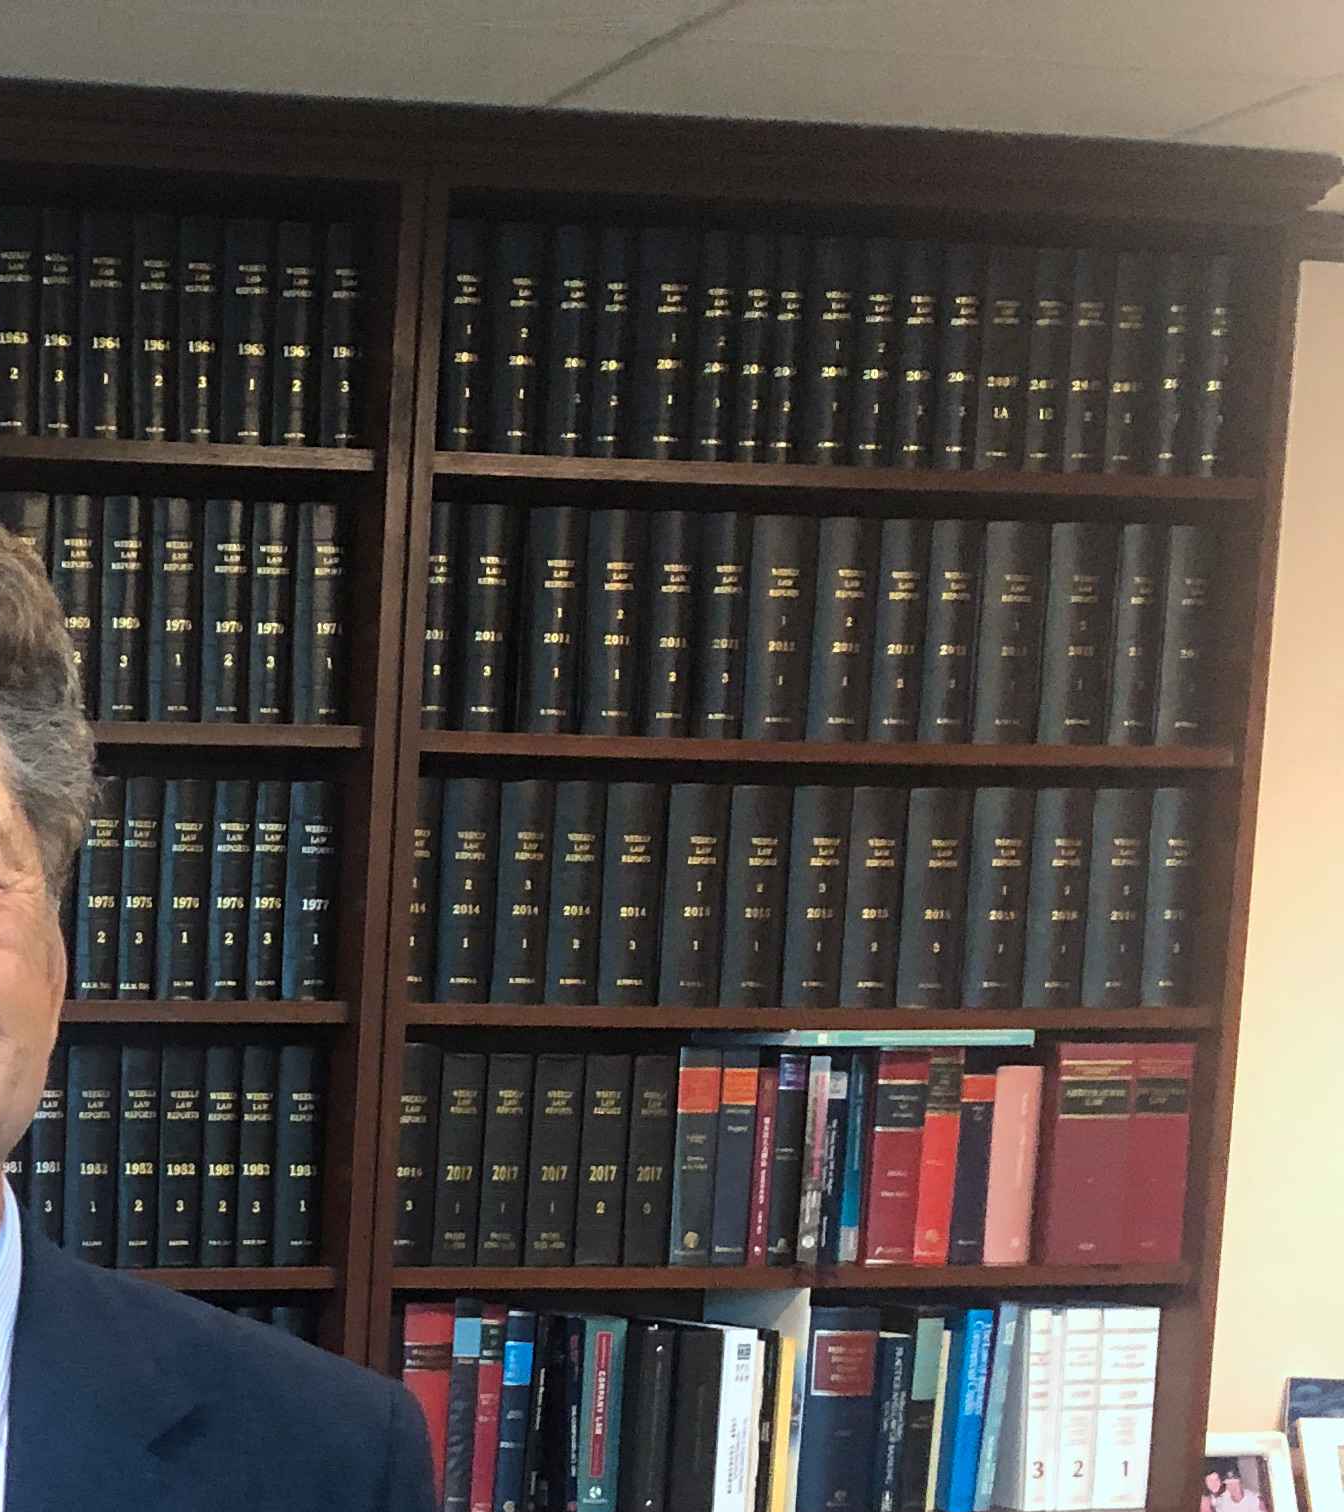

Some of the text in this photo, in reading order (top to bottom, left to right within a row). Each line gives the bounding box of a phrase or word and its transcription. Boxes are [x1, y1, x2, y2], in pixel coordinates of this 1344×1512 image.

[0, 332, 29, 345] 1963
[10, 368, 18, 380] 2
[103, 373, 109, 385] 1
[154, 375, 163, 387] 2
[73, 651, 81, 663] 2
[120, 656, 128, 667] 3
[175, 654, 181, 665] 1
[224, 654, 233, 666] 2
[266, 656, 275, 668] 3
[126, 896, 153, 908] 1975
[217, 897, 244, 909] 1976
[453, 904, 480, 915] 2014
[512, 905, 538, 916] 2014
[563, 905, 590, 917] 2014
[620, 907, 647, 918] 2014
[97, 932, 106, 943] 2
[135, 932, 143, 944] 3
[182, 932, 188, 943] 1
[225, 933, 234, 944] 2
[264, 933, 272, 944] 3
[313, 934, 319, 945] 1
[125, 1161, 153, 1175] 1982
[167, 1163, 195, 1176] 1982
[446, 1165, 472, 1181] 2017
[492, 1165, 519, 1181] 2017
[542, 1165, 568, 1181] 2017
[589, 1165, 617, 1182] 2017
[637, 1166, 663, 1182] 2017
[44, 1201, 53, 1213] 3
[90, 1200, 97, 1213] 1
[134, 1199, 144, 1211] 2
[175, 1199, 185, 1212] 3
[218, 1200, 227, 1213] 2
[252, 1201, 260, 1213] 3
[596, 1201, 605, 1214] 2
[595, 1371, 607, 1413] COMPANY
[1033, 1462, 1044, 1478] 3
[1073, 1460, 1084, 1477] 2
[1122, 1461, 1129, 1476] 1
